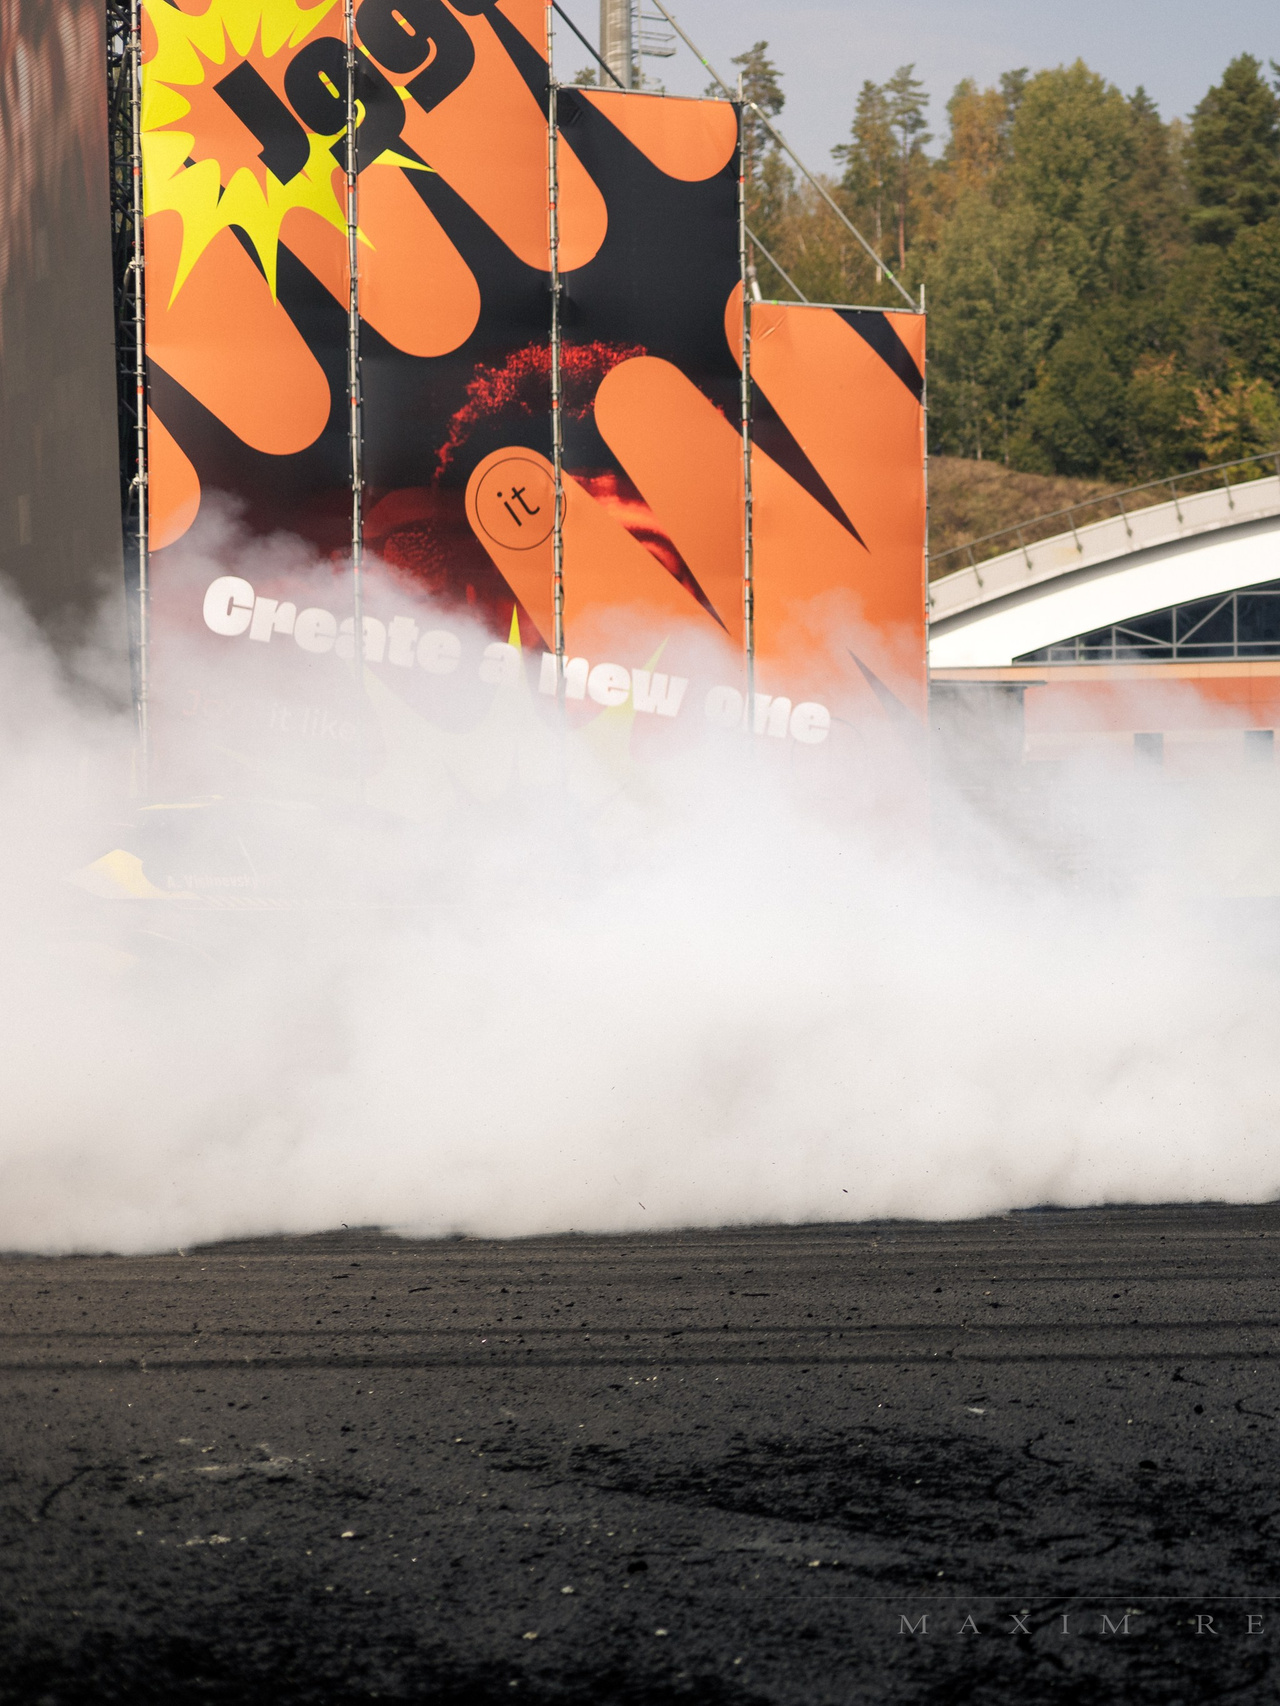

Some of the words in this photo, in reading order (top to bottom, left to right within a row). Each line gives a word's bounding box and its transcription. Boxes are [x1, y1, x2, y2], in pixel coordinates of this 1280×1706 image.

[497, 487, 540, 526] it
[203, 576, 461, 675] Create
[478, 641, 521, 685] a
[538, 651, 689, 717] new
[704, 685, 831, 743] one
